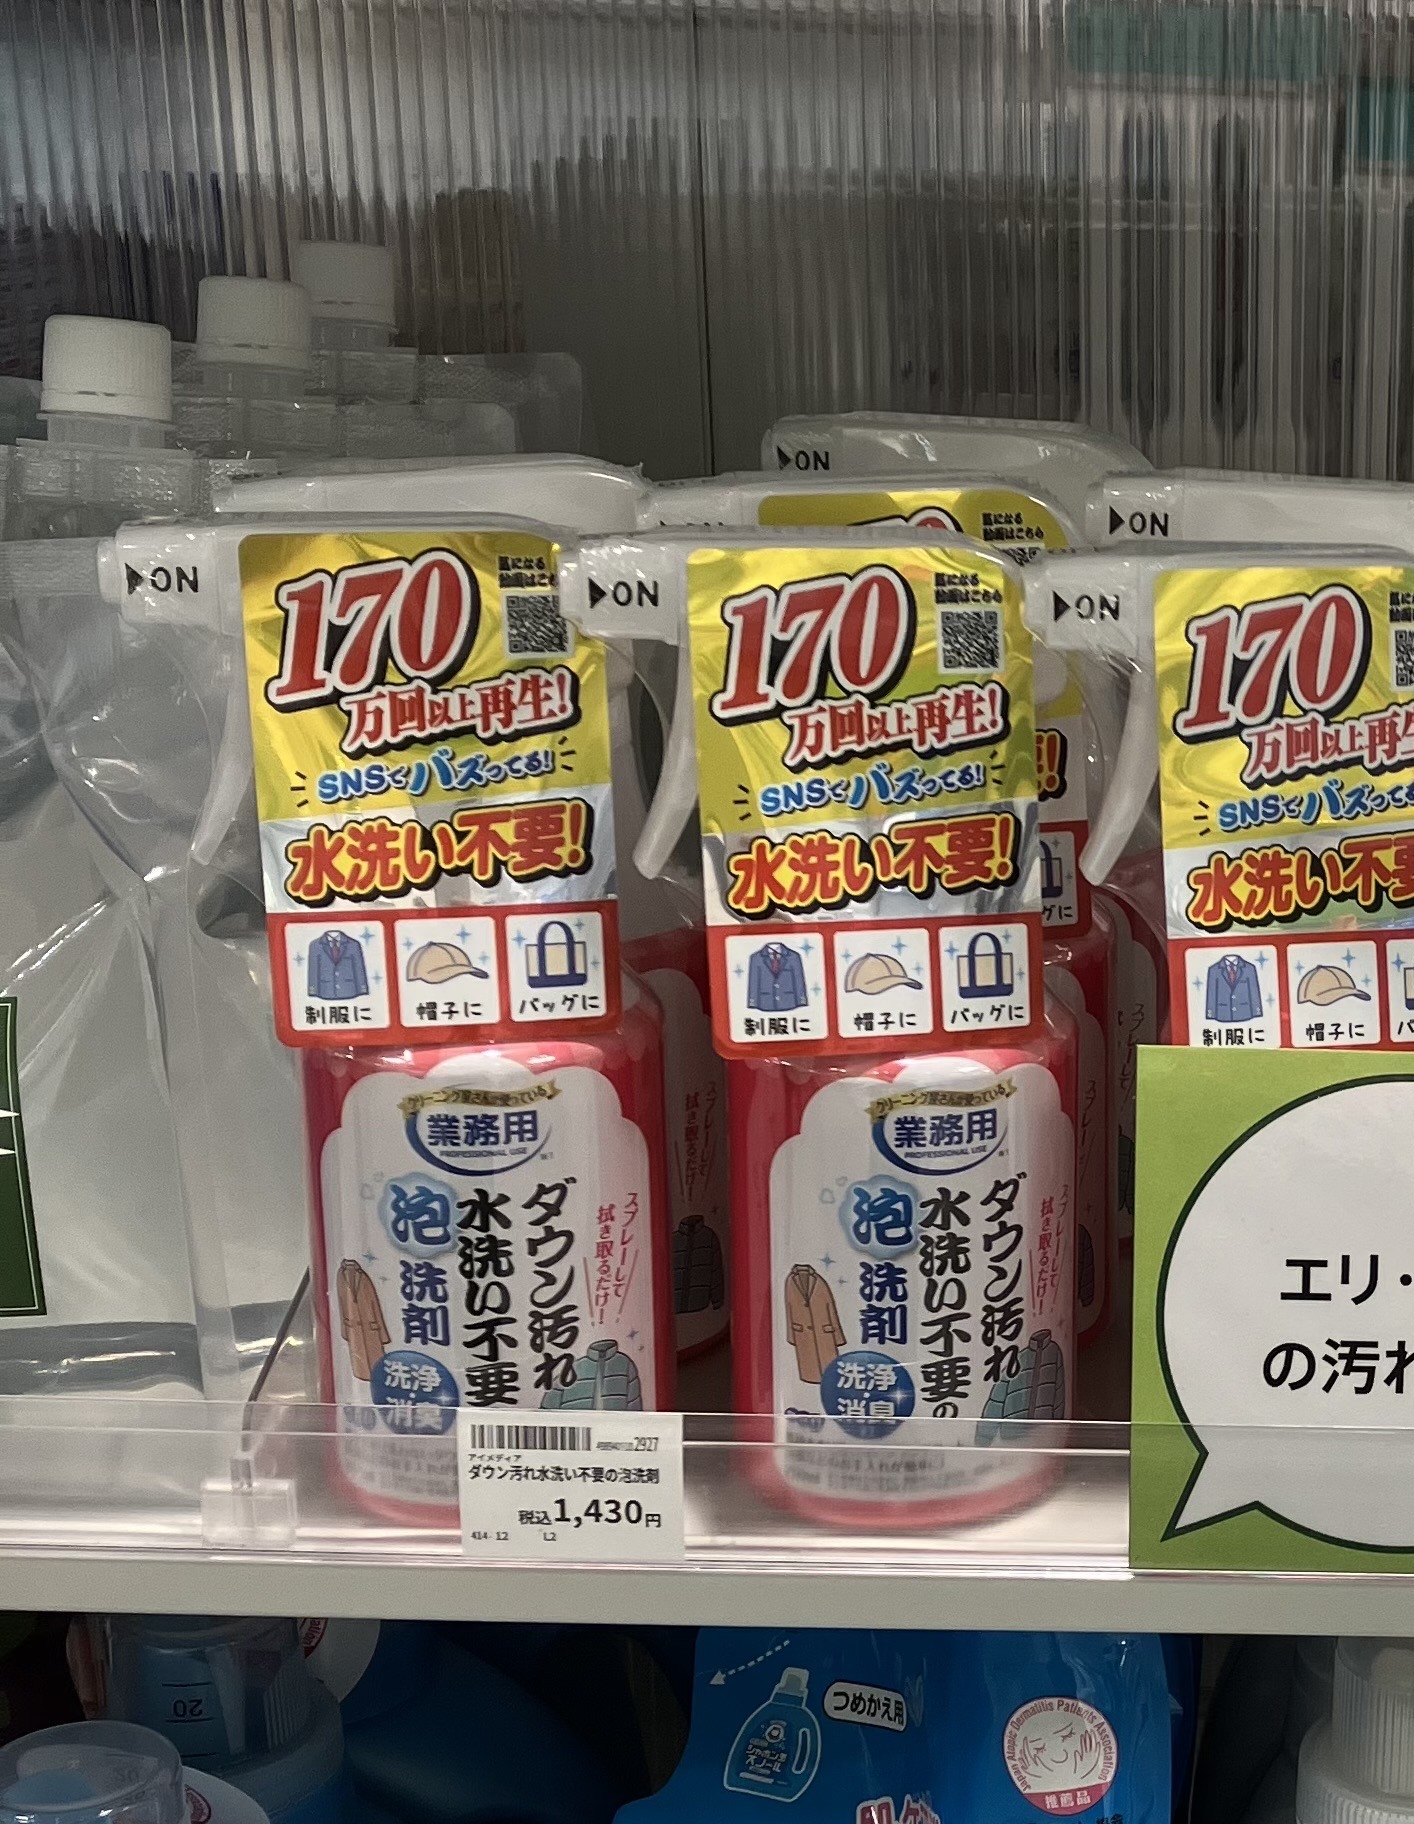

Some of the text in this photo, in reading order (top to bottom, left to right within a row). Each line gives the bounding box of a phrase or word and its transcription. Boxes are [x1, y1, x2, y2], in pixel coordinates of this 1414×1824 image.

[794, 449, 830, 471] ON
[1130, 511, 1170, 538] ON
[149, 566, 199, 593] ON
[611, 579, 660, 608] ON
[1075, 593, 1121, 621] ON
[270, 552, 474, 706] 170
[716, 569, 908, 717] 170
[1178, 588, 1368, 734] 170
[347, 671, 572, 748] 万回以上再生！
[788, 687, 1004, 762] 万回以上再生！
[317, 749, 555, 802] SNSでバズってる！
[759, 762, 985, 814] SNSでバズってる！
[286, 803, 588, 898] 水洗い不要！
[729, 816, 1014, 911] 水洗い不要！
[304, 1004, 373, 1025] 制服に
[416, 1000, 483, 1021] 帽子に
[519, 994, 601, 1014] バッグに
[853, 1011, 918, 1032] 帽子に
[950, 1004, 1026, 1024] バッグに
[743, 1016, 812, 1036] 制服に
[1201, 1026, 1266, 1047] 制服に
[1304, 1020, 1366, 1042] 帽子に
[426, 1108, 539, 1148] 業務用
[894, 1107, 999, 1149] 業務用
[612, 1192, 639, 1298] スプレーして
[521, 1176, 580, 1391] ダウン汚れ
[979, 1171, 1028, 1384] ダウン汚れ
[455, 1188, 521, 1407] 水洗い不要
[918, 1186, 972, 1419] 水洗い不要の
[383, 1359, 443, 1392] 洗浄
[836, 1360, 898, 1392] 洗浄
[468, 1453, 522, 1463] アイメディア
[468, 1464, 660, 1485] ダウン汚れ水洗い不要の泡洗剤
[832, 1690, 904, 1727] つめかえ用
[1006, 1699, 1116, 1792] Japan Atopic Dermatitis Patients Association
